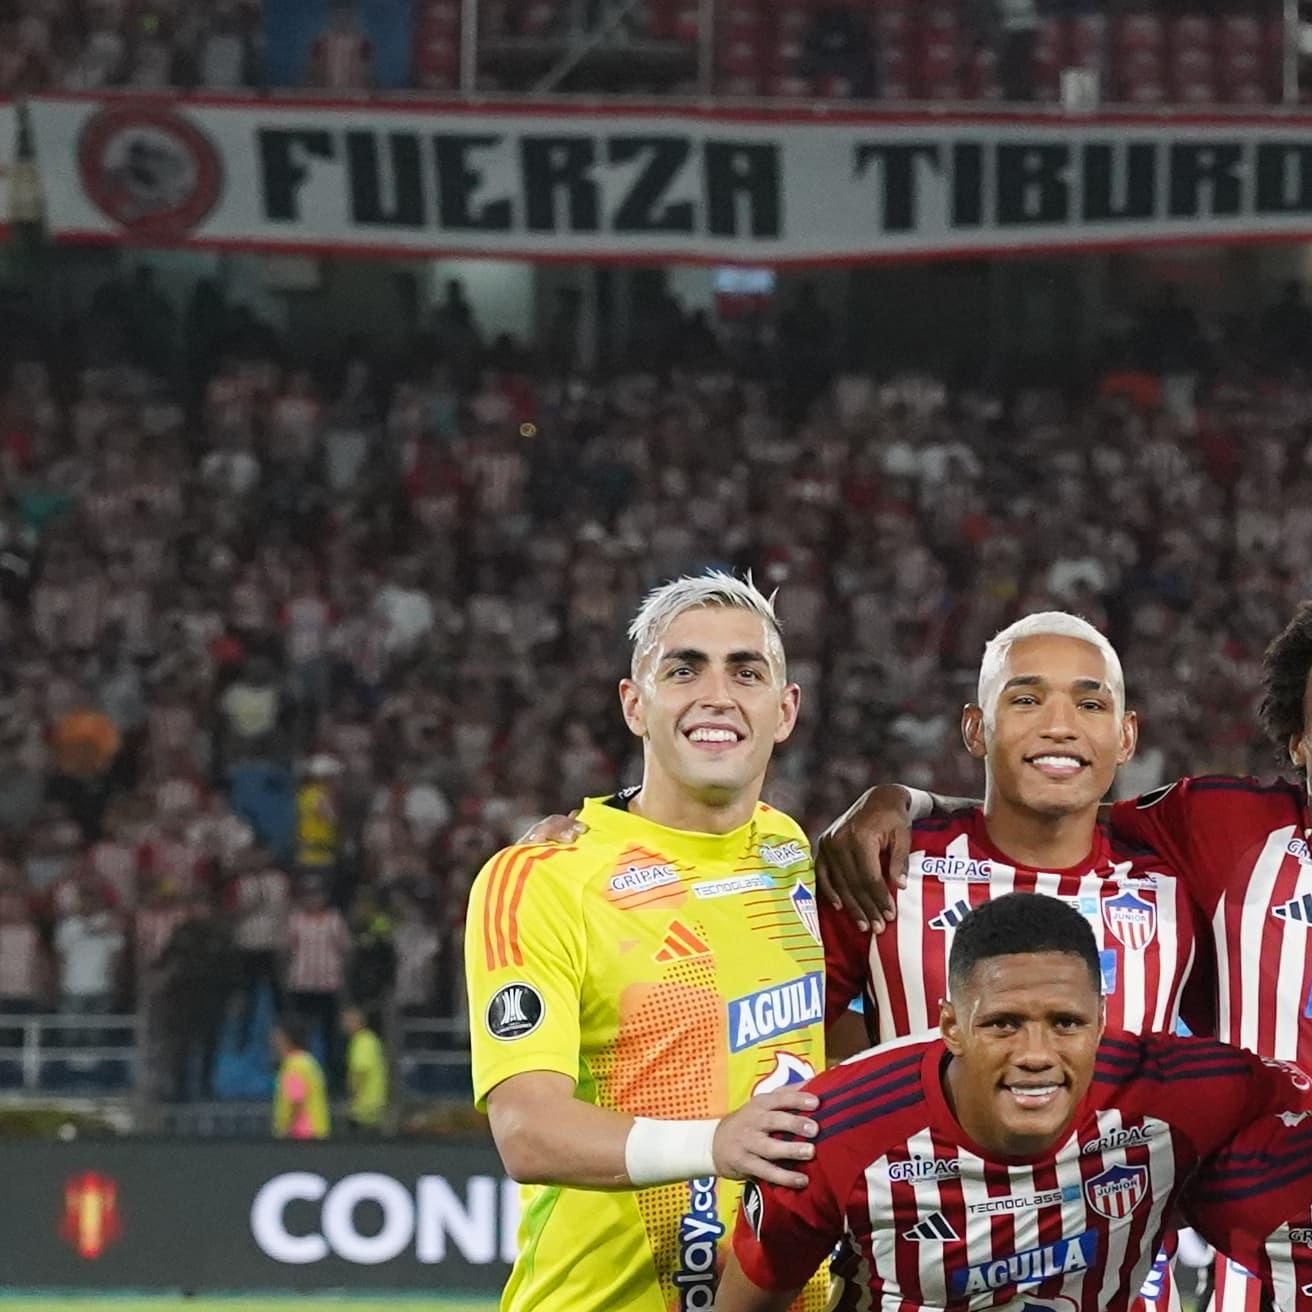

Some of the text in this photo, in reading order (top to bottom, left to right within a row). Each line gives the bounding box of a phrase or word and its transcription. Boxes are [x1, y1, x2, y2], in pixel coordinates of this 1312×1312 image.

[258, 125, 783, 239] FUERZA
[250, 1172, 522, 1265] CON
[963, 1237, 1088, 1297] AGUILA
